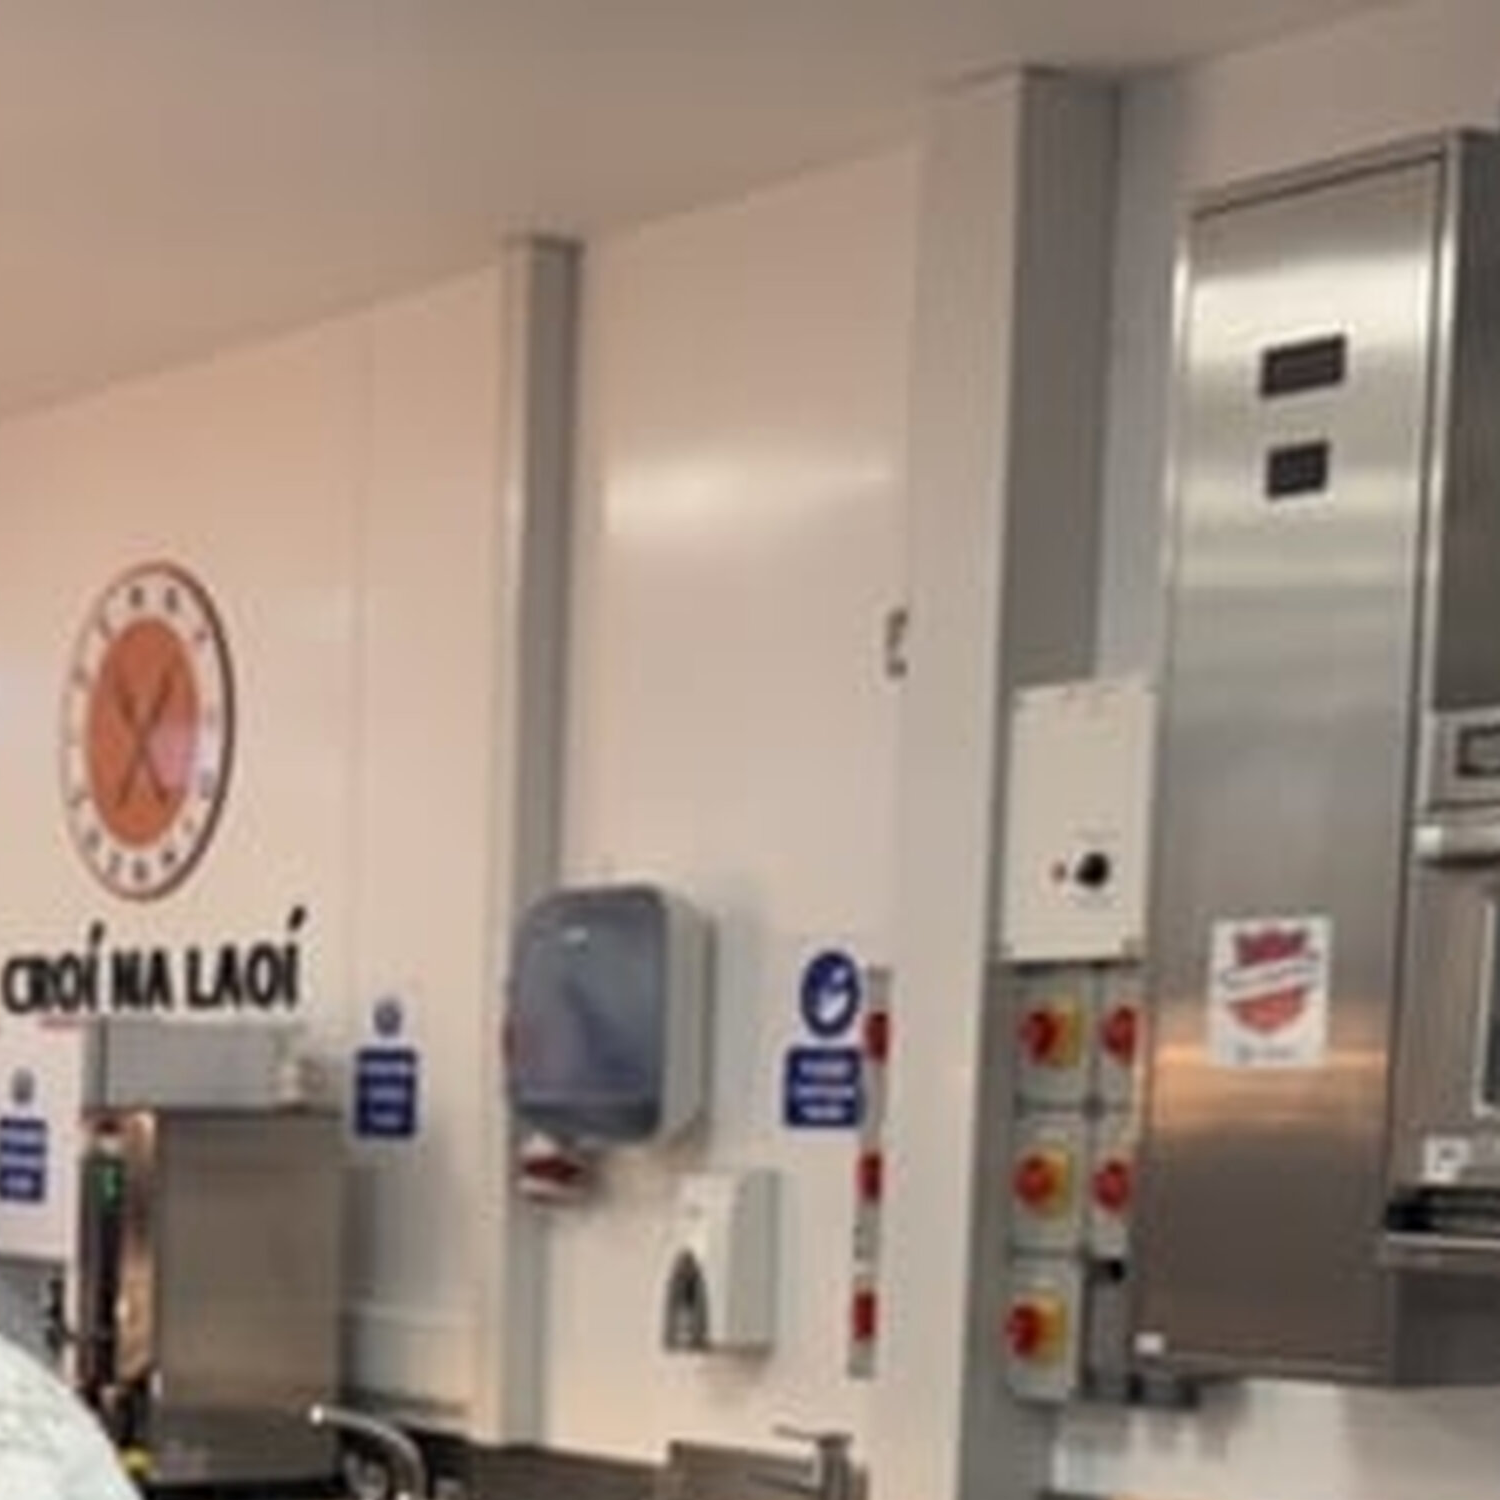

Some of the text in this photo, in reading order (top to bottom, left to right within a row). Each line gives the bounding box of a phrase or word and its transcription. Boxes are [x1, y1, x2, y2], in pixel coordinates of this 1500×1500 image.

[0, 905, 307, 1014] CROÍ NA LAOÍ
